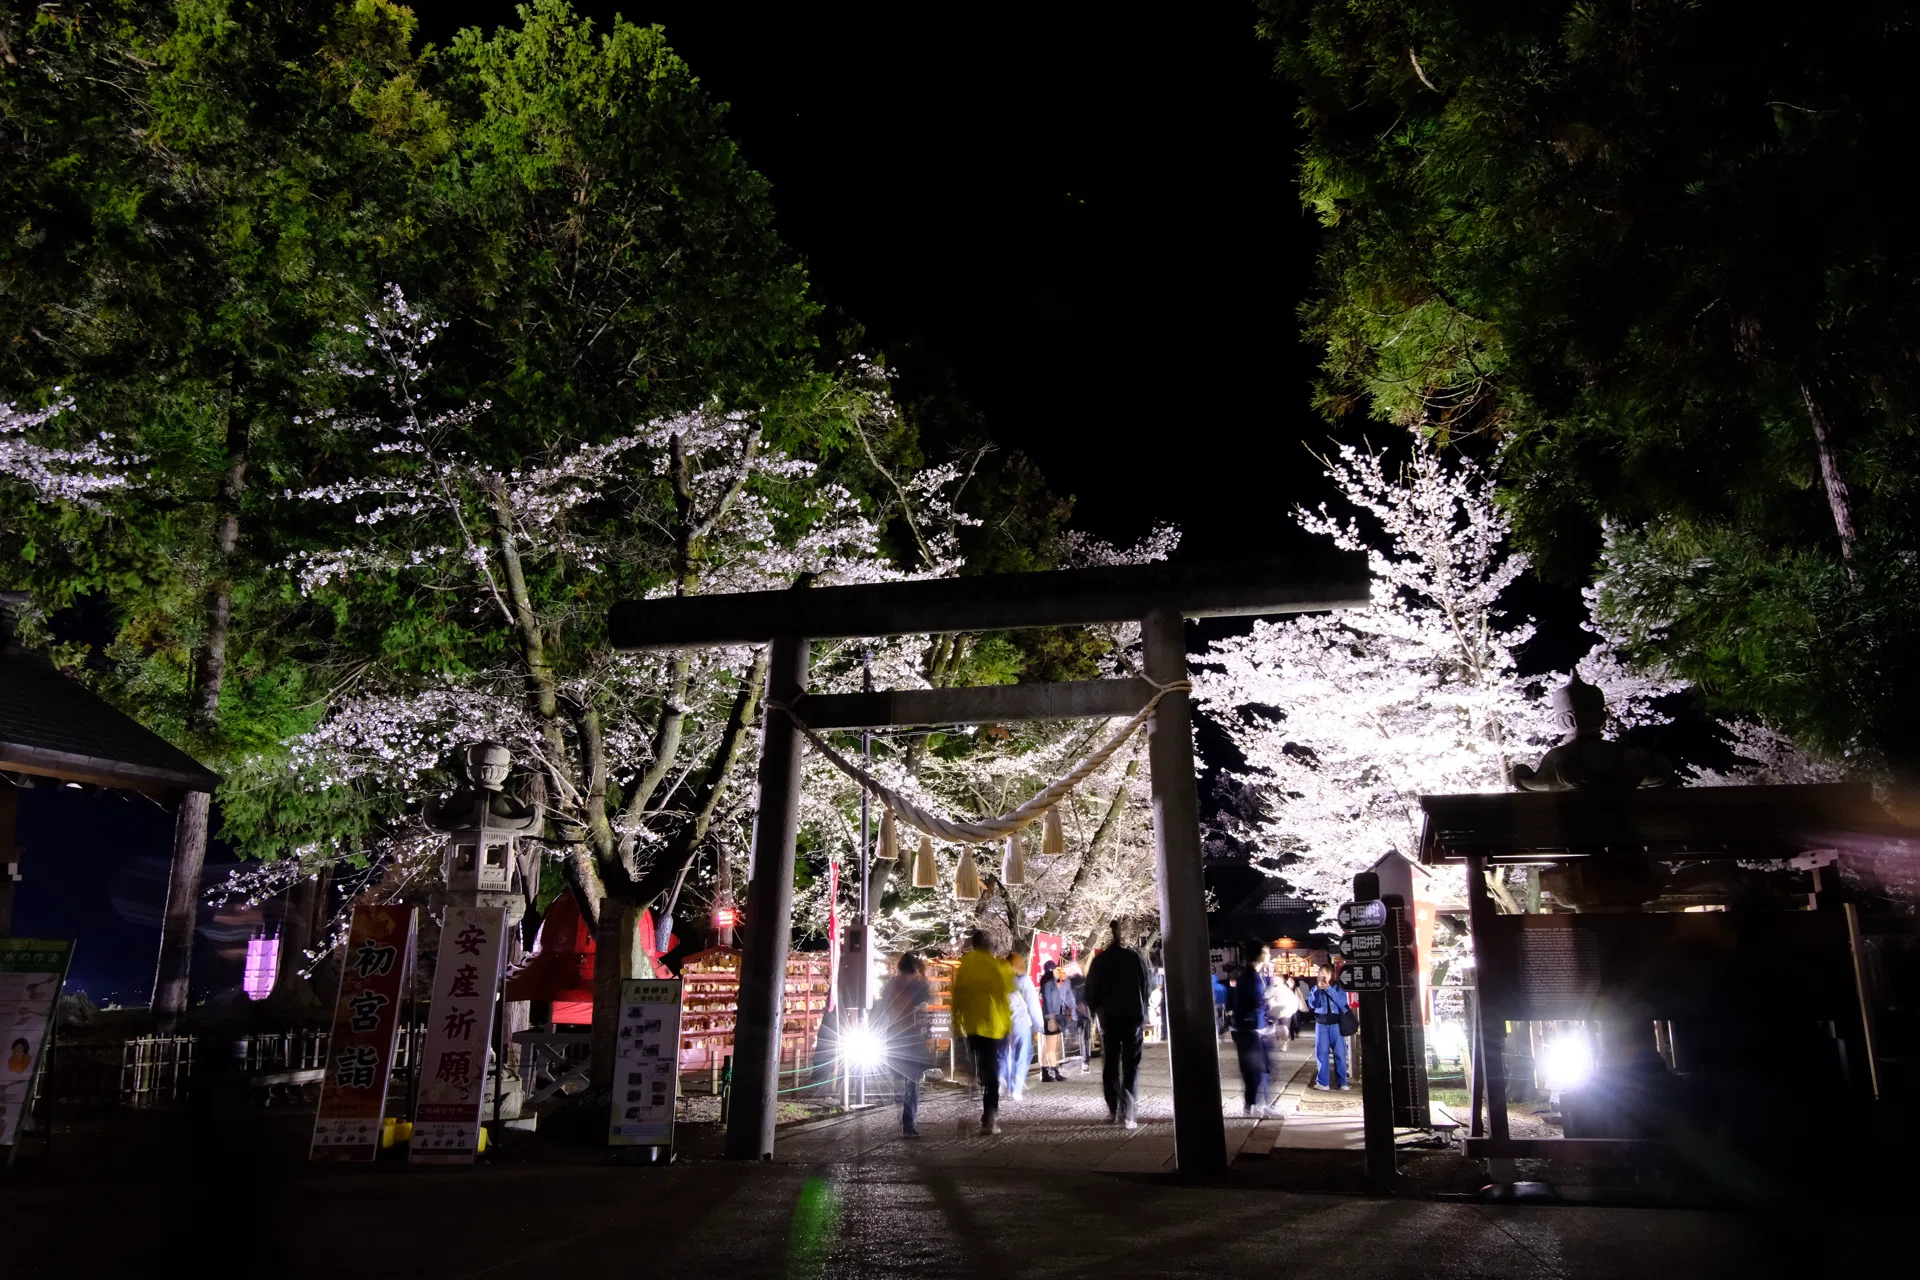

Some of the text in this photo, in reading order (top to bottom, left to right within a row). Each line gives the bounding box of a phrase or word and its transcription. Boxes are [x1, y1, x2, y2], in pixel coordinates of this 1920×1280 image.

[4, 952, 60, 963] 水の作法
[1352, 935, 1382, 949] 真田井戸
[335, 939, 398, 1089] 初宮詣
[435, 924, 487, 1084] 安産祈願
